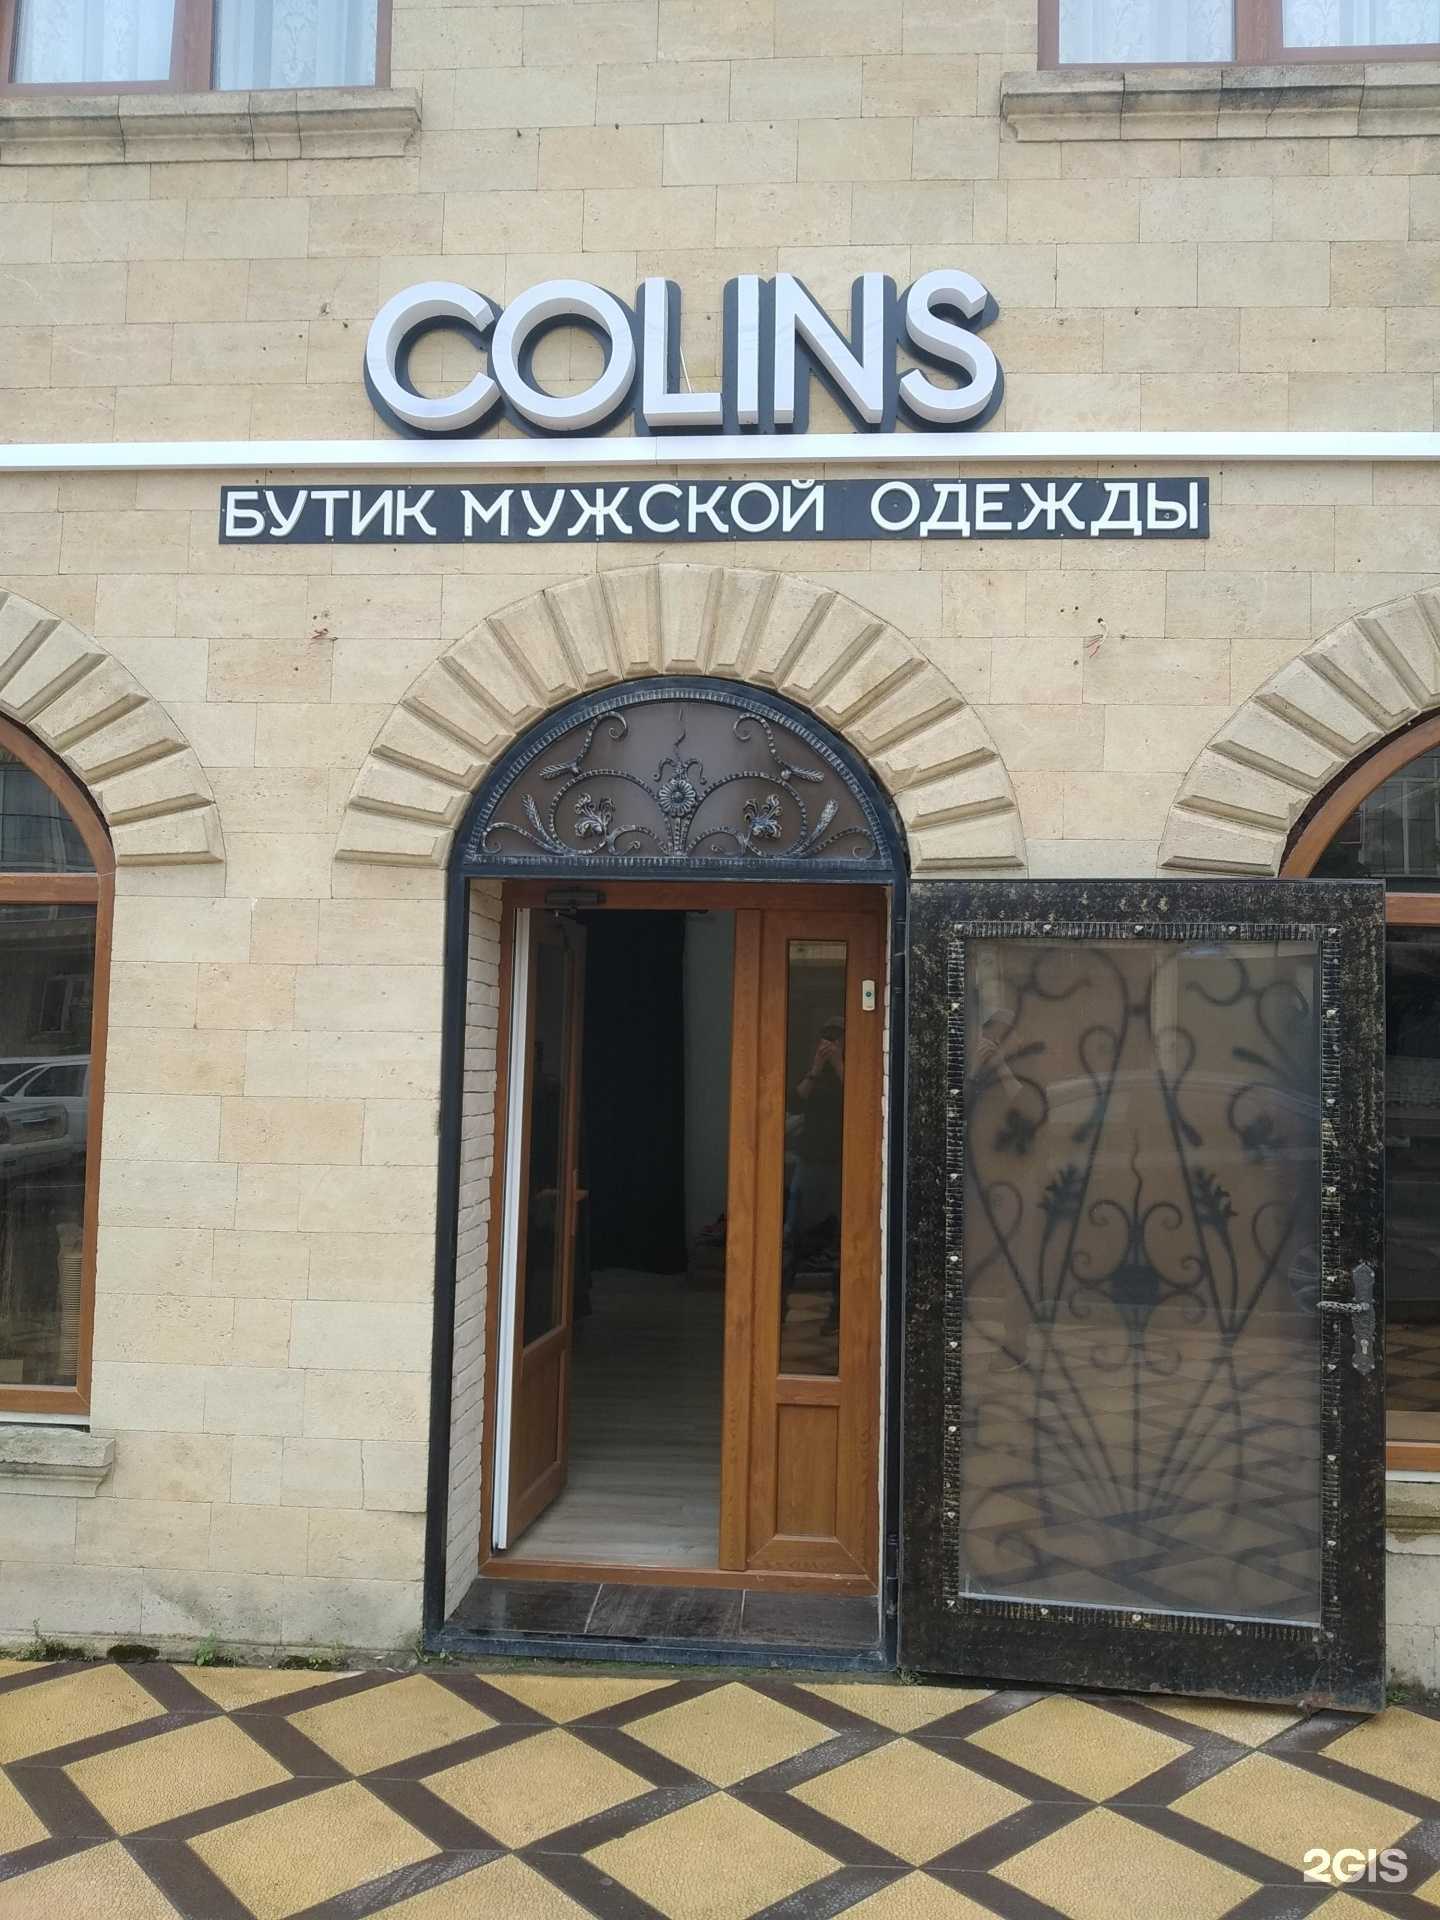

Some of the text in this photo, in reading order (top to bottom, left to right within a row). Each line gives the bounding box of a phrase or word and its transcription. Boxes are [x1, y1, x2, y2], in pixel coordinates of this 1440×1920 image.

[365, 268, 998, 432] COLINS
[224, 479, 1199, 537] БУТИК МУЖСКОЙ ОДЕЖДЫ
